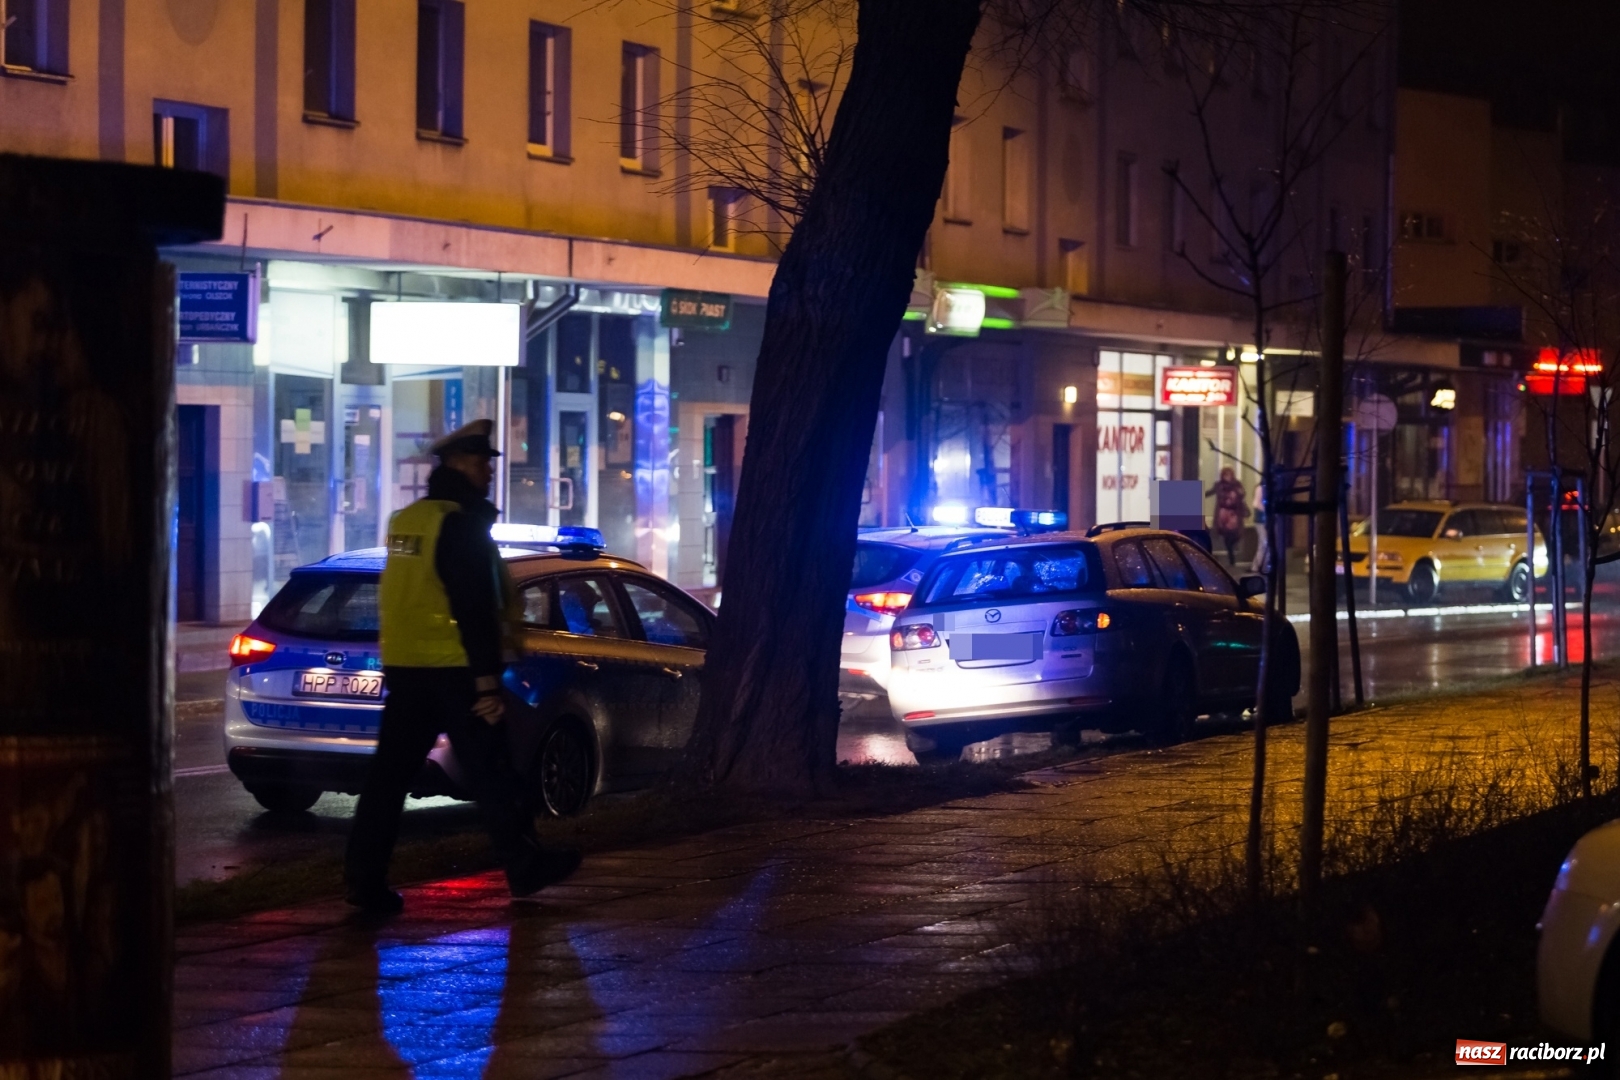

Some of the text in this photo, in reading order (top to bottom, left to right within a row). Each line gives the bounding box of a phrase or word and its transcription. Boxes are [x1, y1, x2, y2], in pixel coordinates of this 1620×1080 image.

[1166, 377, 1232, 393] KANTOR
[302, 674, 379, 695] HPP R022
[251, 703, 300, 719] POLICJA
